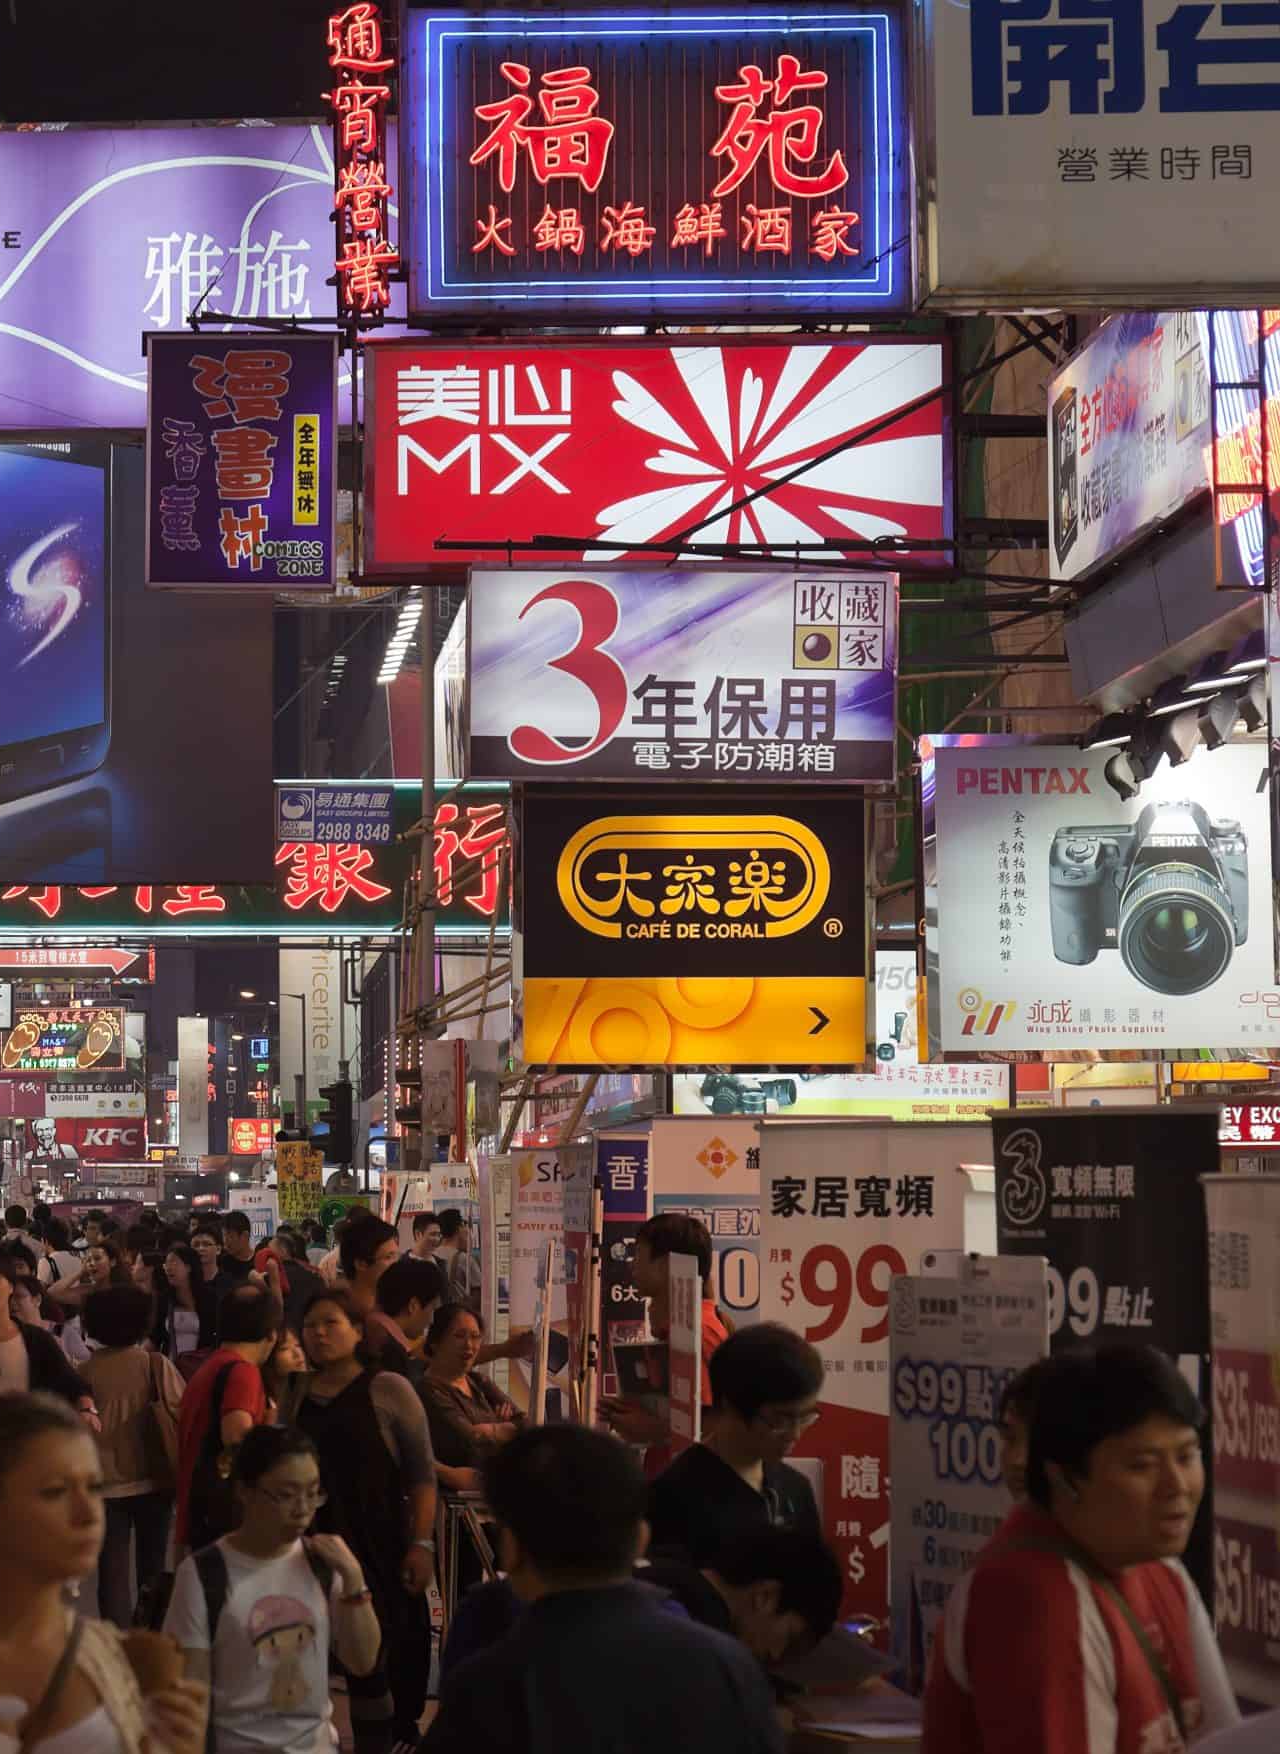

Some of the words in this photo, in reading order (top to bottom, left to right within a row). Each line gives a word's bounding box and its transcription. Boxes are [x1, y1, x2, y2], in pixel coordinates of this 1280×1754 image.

[470, 55, 849, 198] 福苑
[322, 3, 399, 309] 通宵營業
[1057, 145, 1252, 182] 營業時間
[473, 204, 860, 262] 火鍋海鮮酒家
[143, 230, 311, 332] 雅施
[396, 364, 572, 426] 美心
[297, 423, 316, 514] 全年無休
[397, 433, 572, 495] MX
[253, 540, 322, 558] COMICS
[278, 560, 324, 577] ZONE
[799, 585, 880, 625] 收藏
[844, 630, 881, 667] 家
[632, 742, 836, 773] 電子防潮箱
[956, 768, 1091, 794] PENTAX
[317, 792, 390, 808] 易通集團
[317, 823, 351, 841] 2988
[355, 823, 390, 841] 8348
[1151, 836, 1197, 847] PENTAX
[626, 920, 671, 938] CAFÉ
[676, 923, 701, 938] DE
[704, 923, 764, 938] CORAL
[83, 1128, 139, 1146] KFC
[607, 1155, 648, 1191] 香
[771, 1175, 934, 1218] 家居寬頻
[931, 1420, 1002, 1482] 100
[841, 1455, 890, 1499] 隨
